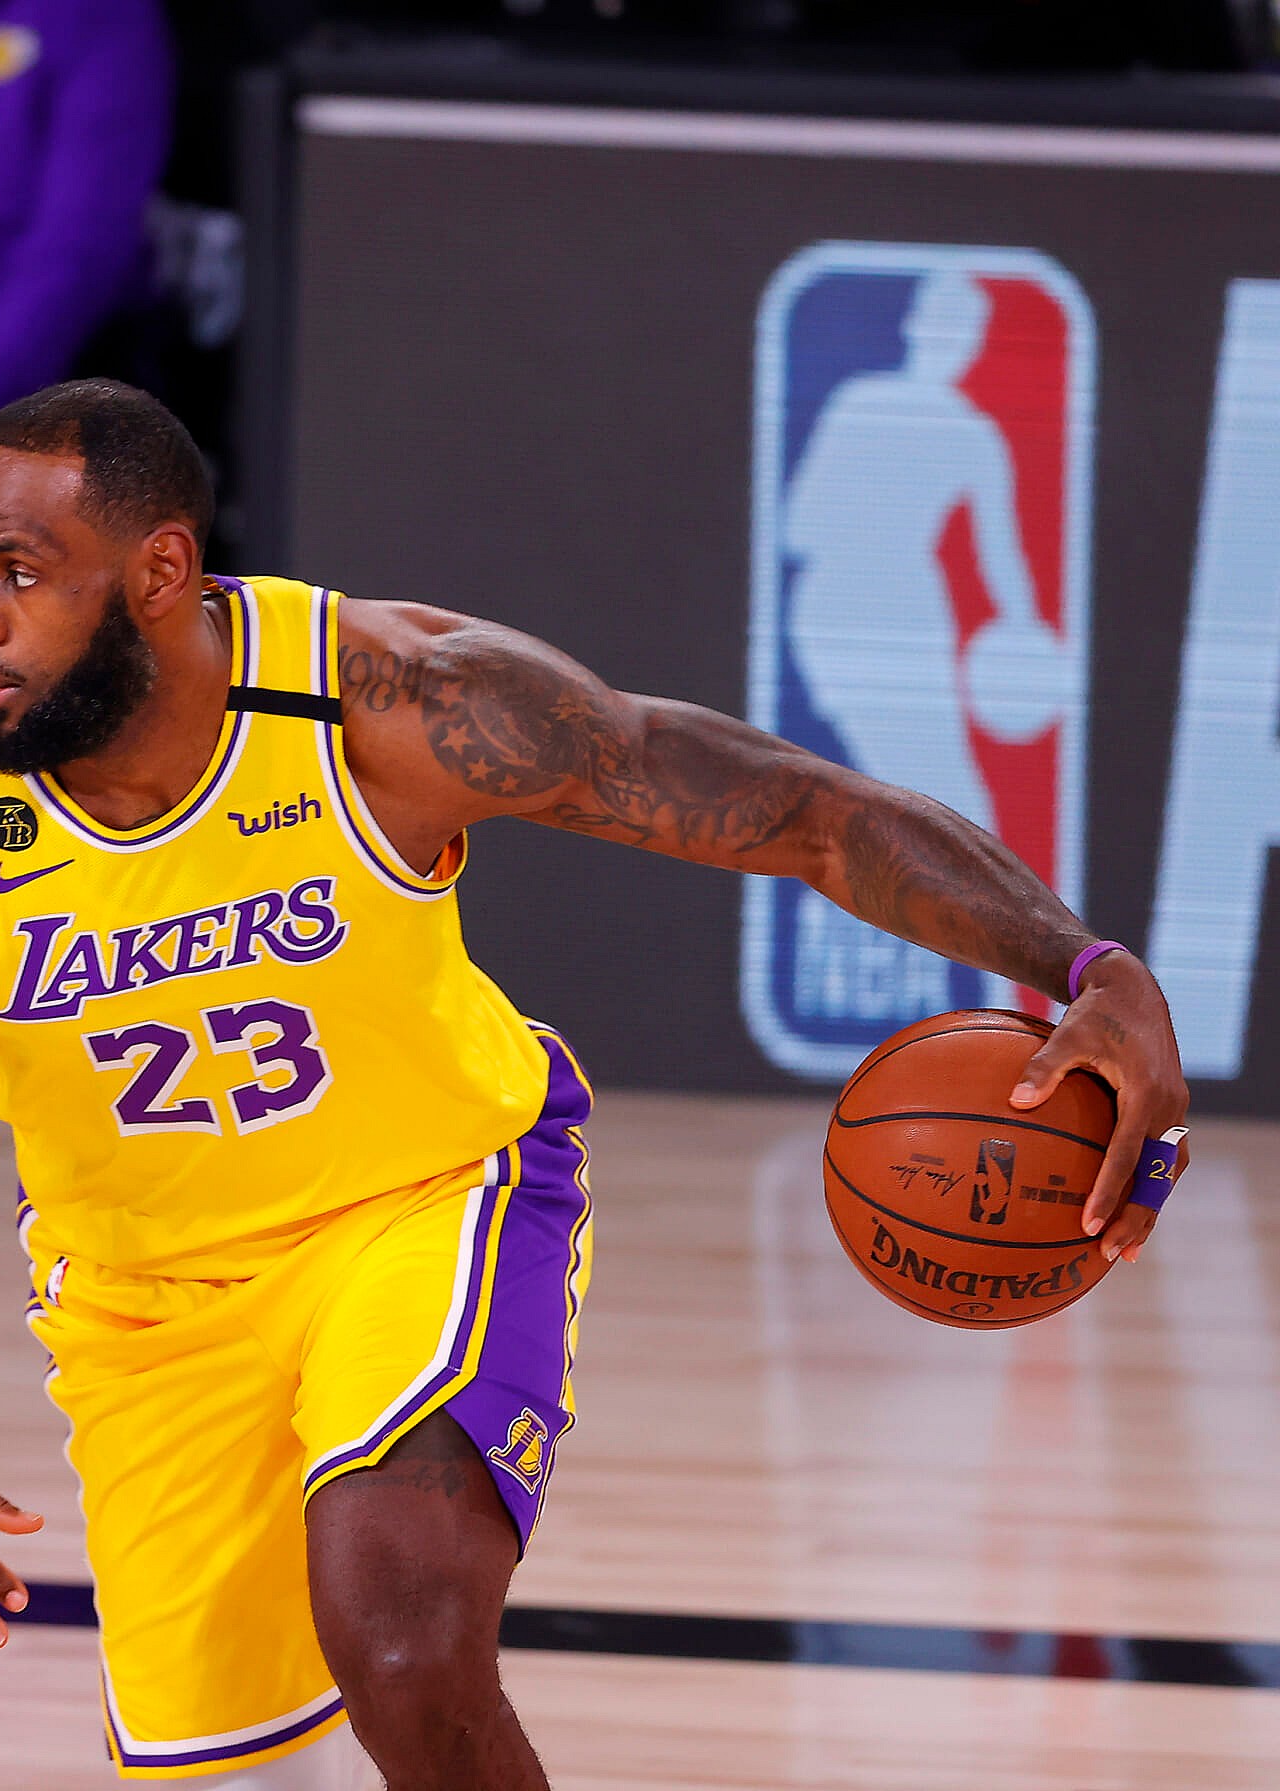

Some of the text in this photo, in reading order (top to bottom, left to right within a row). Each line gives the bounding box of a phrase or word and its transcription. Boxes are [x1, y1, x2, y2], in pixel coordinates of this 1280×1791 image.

[226, 792, 322, 838] wish
[81, 997, 335, 1137] 23
[870, 1220, 1089, 1299] SPALDING
